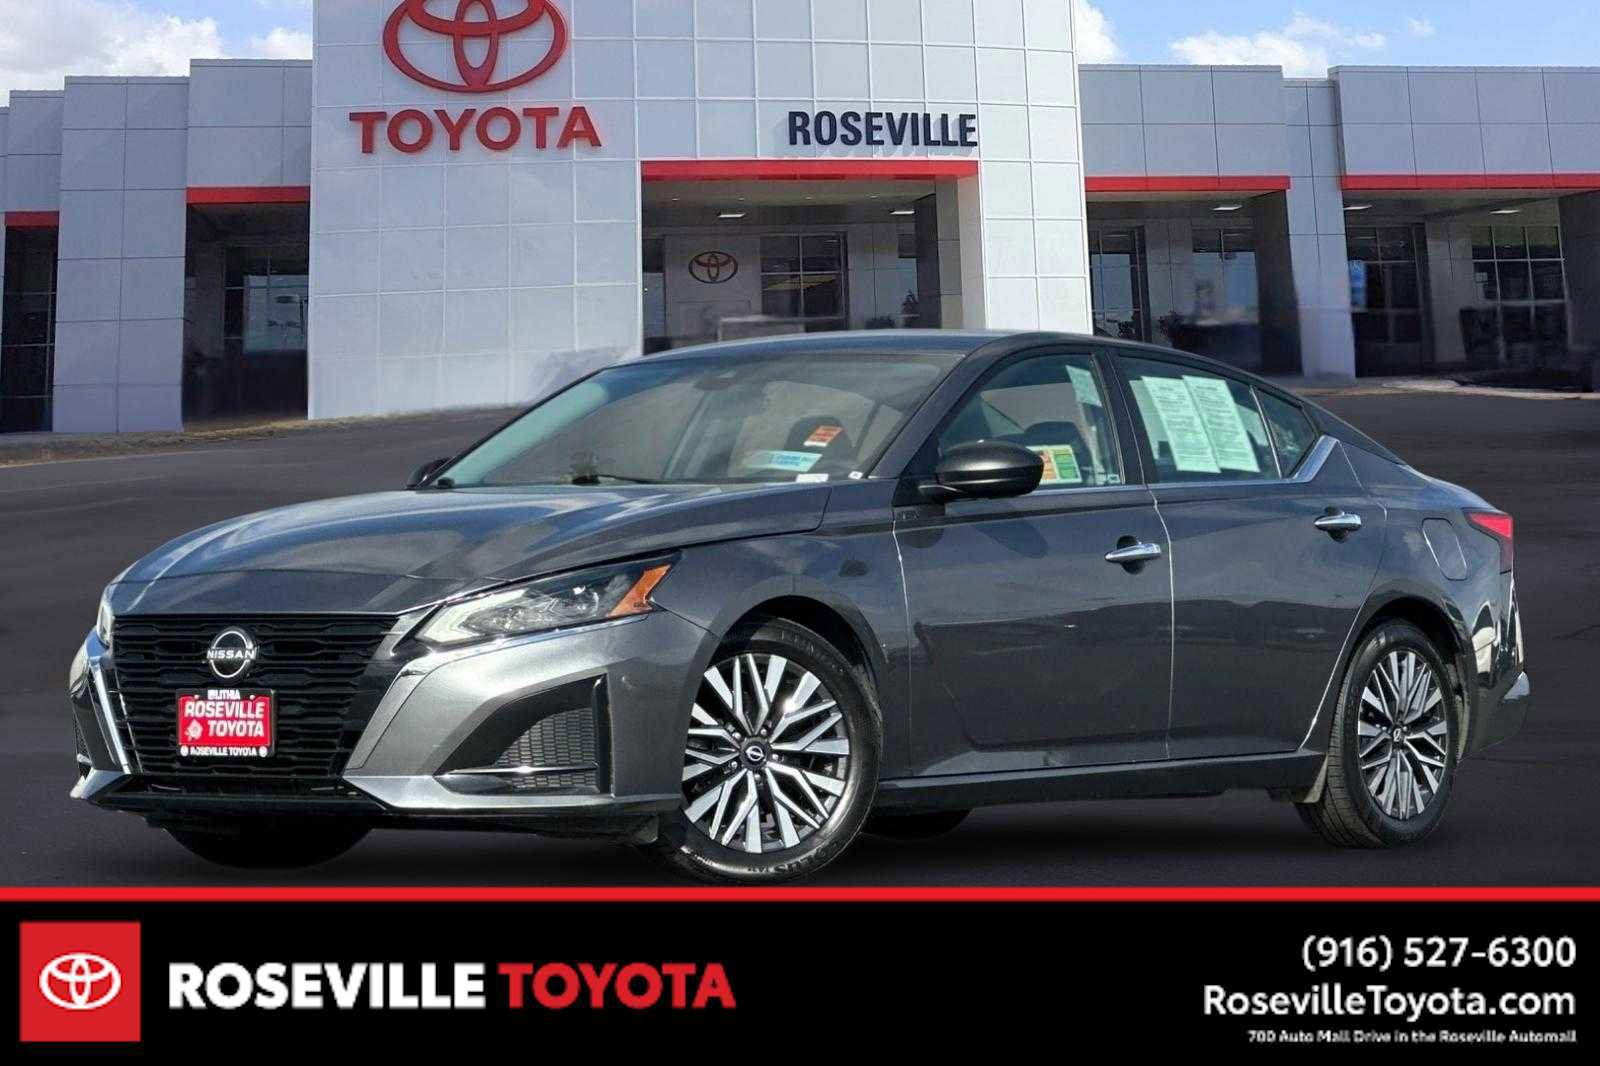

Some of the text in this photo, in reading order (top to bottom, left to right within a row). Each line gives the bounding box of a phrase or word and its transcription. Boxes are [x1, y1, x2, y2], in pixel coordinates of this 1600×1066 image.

[350, 105, 602, 154] TOYOTA
[788, 110, 978, 148] ROSEVILLE
[206, 649, 256, 660] NISSAN
[184, 701, 265, 719] ROSEVILLE
[207, 719, 265, 737] TOYOTA
[189, 746, 257, 756] ROSEVILLE TOYOTA
